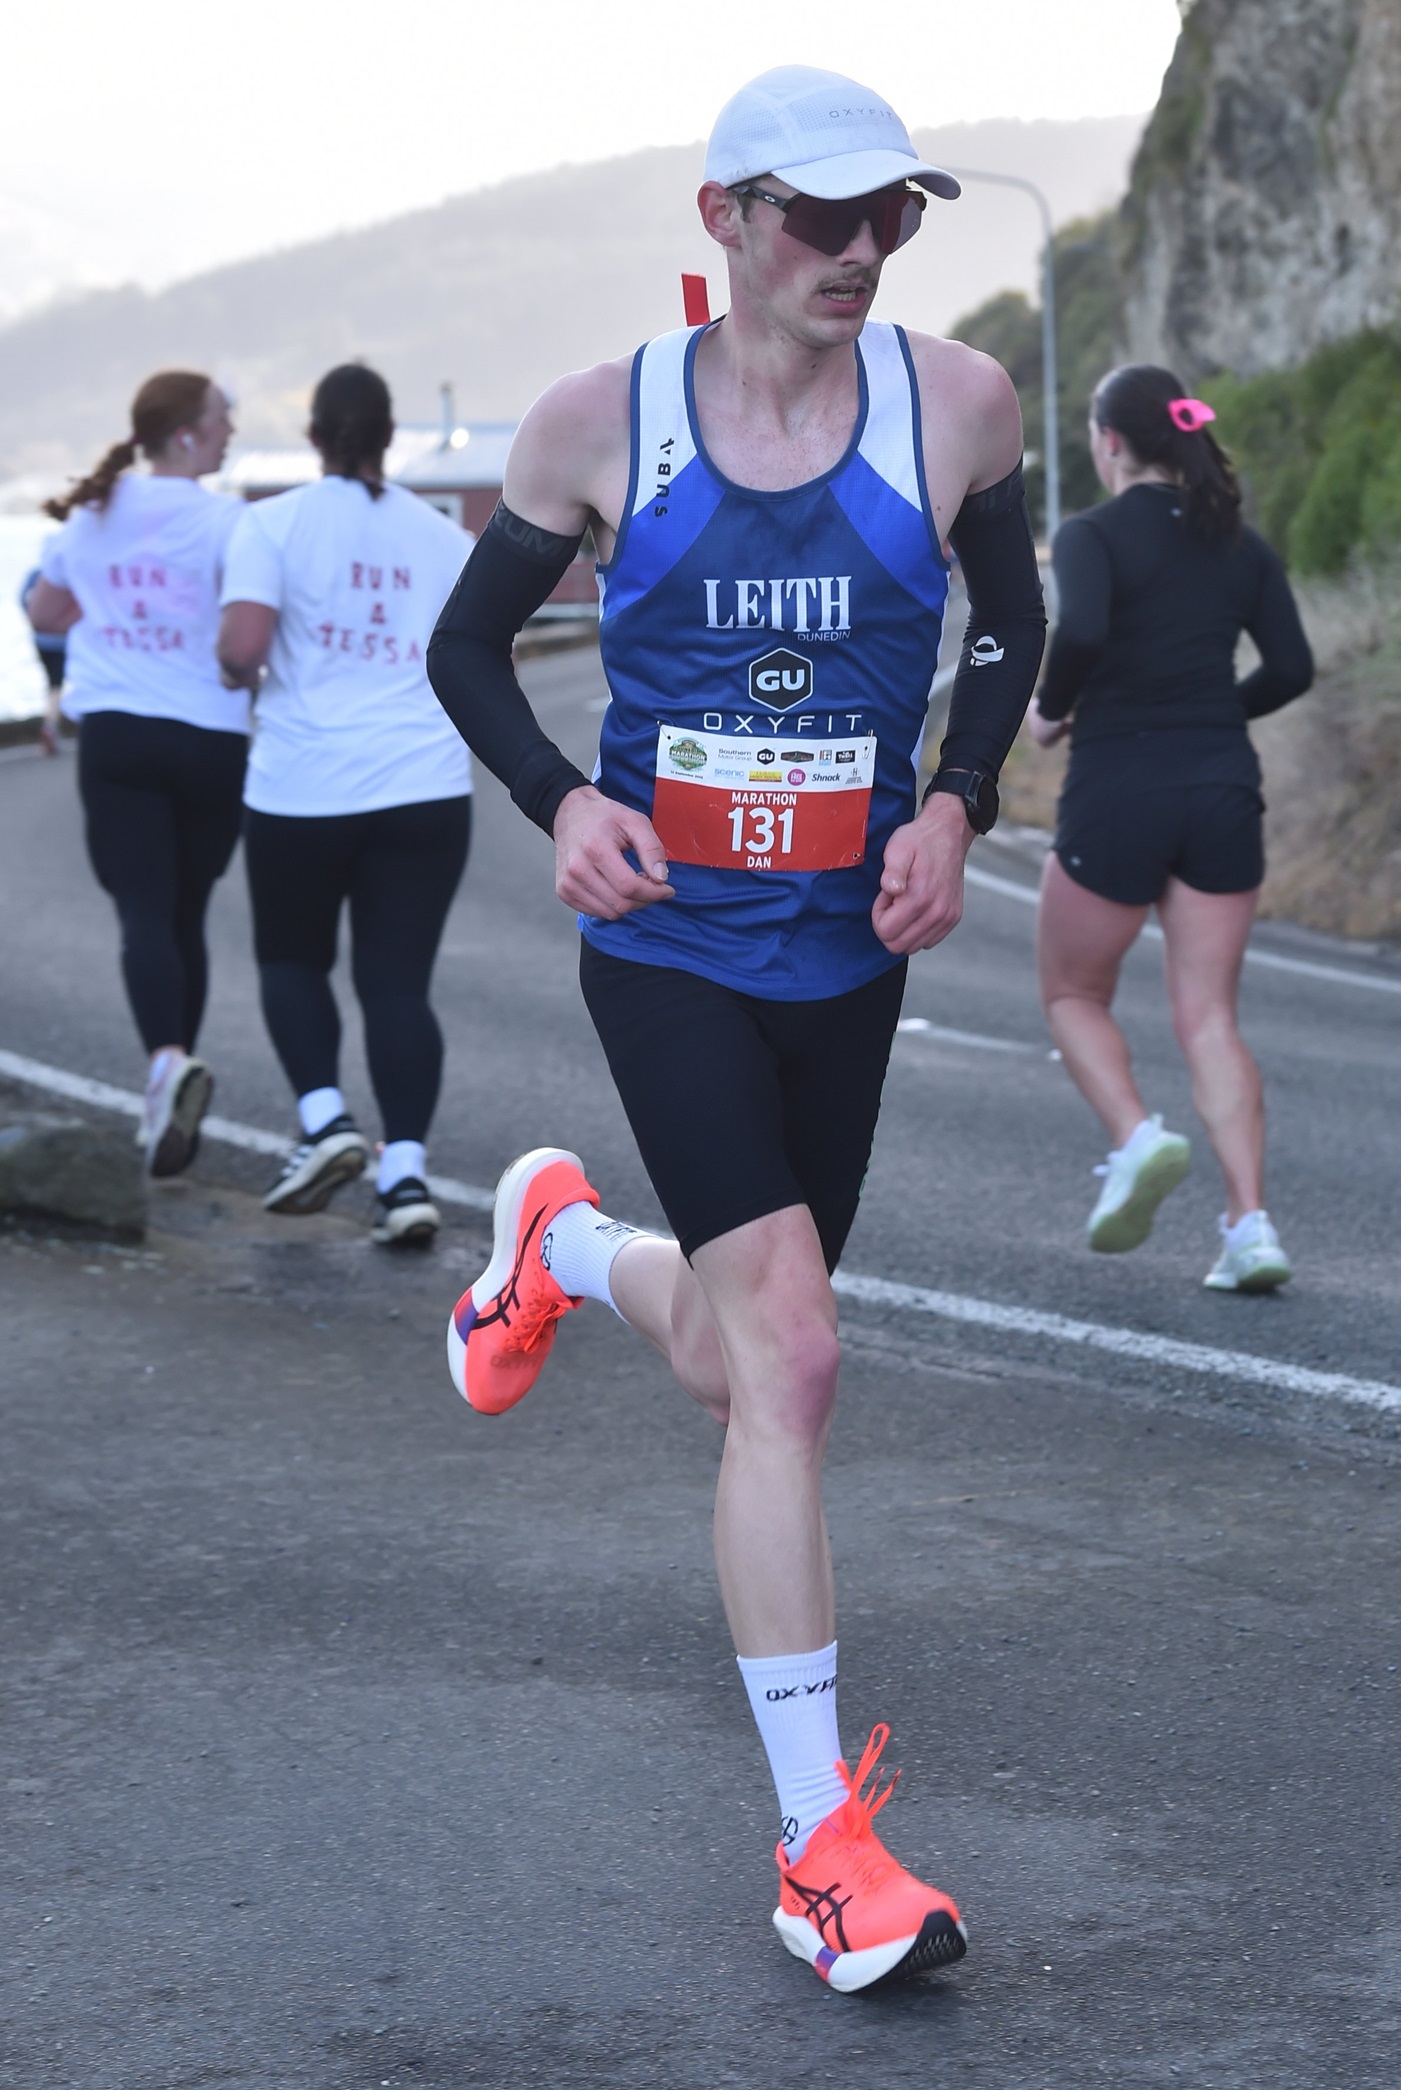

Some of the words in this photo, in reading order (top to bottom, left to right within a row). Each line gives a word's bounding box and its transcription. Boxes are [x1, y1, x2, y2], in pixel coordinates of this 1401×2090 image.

[828, 108, 892, 119] OXYFIT
[351, 562, 410, 590] RUN
[703, 576, 852, 632] LEITH
[318, 622, 421, 665] TESSA
[797, 630, 851, 642] DUNEDIN
[756, 669, 805, 691] GU
[703, 712, 862, 734] OXYFIT
[718, 748, 751, 756] Southern
[811, 773, 841, 782] Shnack
[731, 791, 797, 806] MARATHON
[727, 806, 794, 854] 131
[747, 855, 771, 868] DAN
